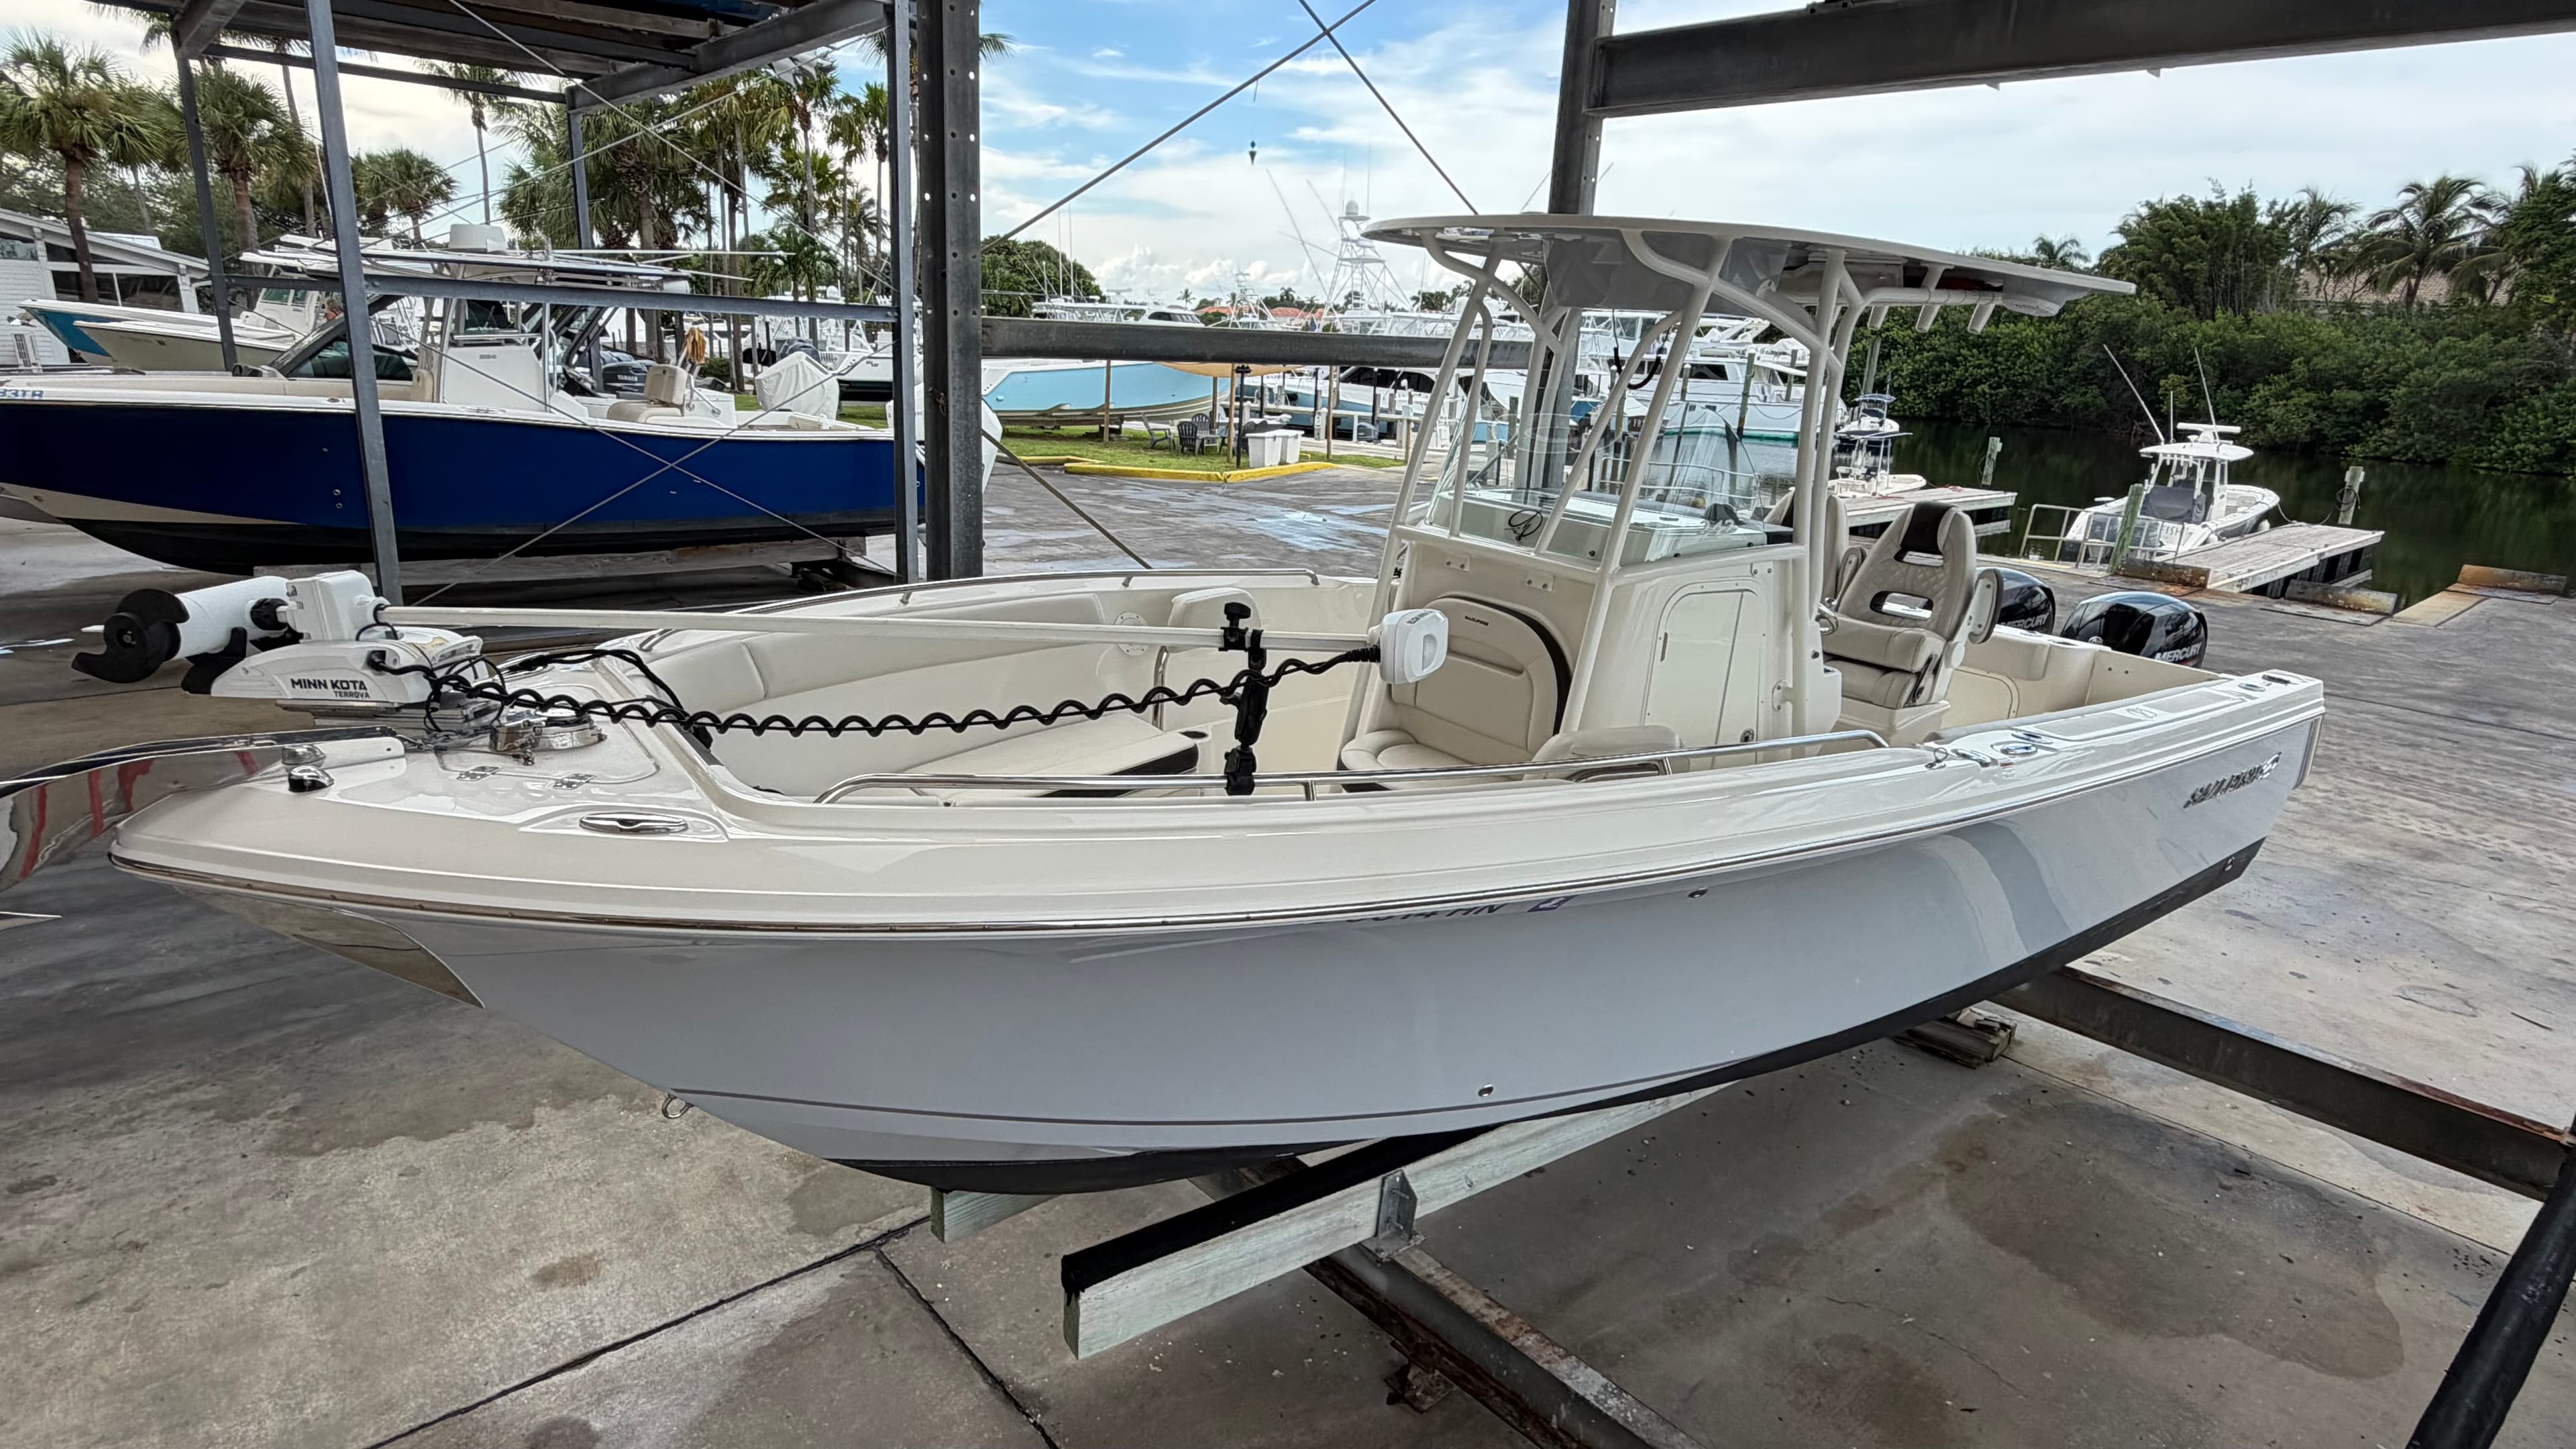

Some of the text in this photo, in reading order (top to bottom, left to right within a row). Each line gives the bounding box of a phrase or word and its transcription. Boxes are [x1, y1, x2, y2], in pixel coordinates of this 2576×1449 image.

[2154, 642, 2203, 662] MERCURY
[290, 678, 368, 691] MINN KOTA
[333, 690, 371, 698] TERROVA
